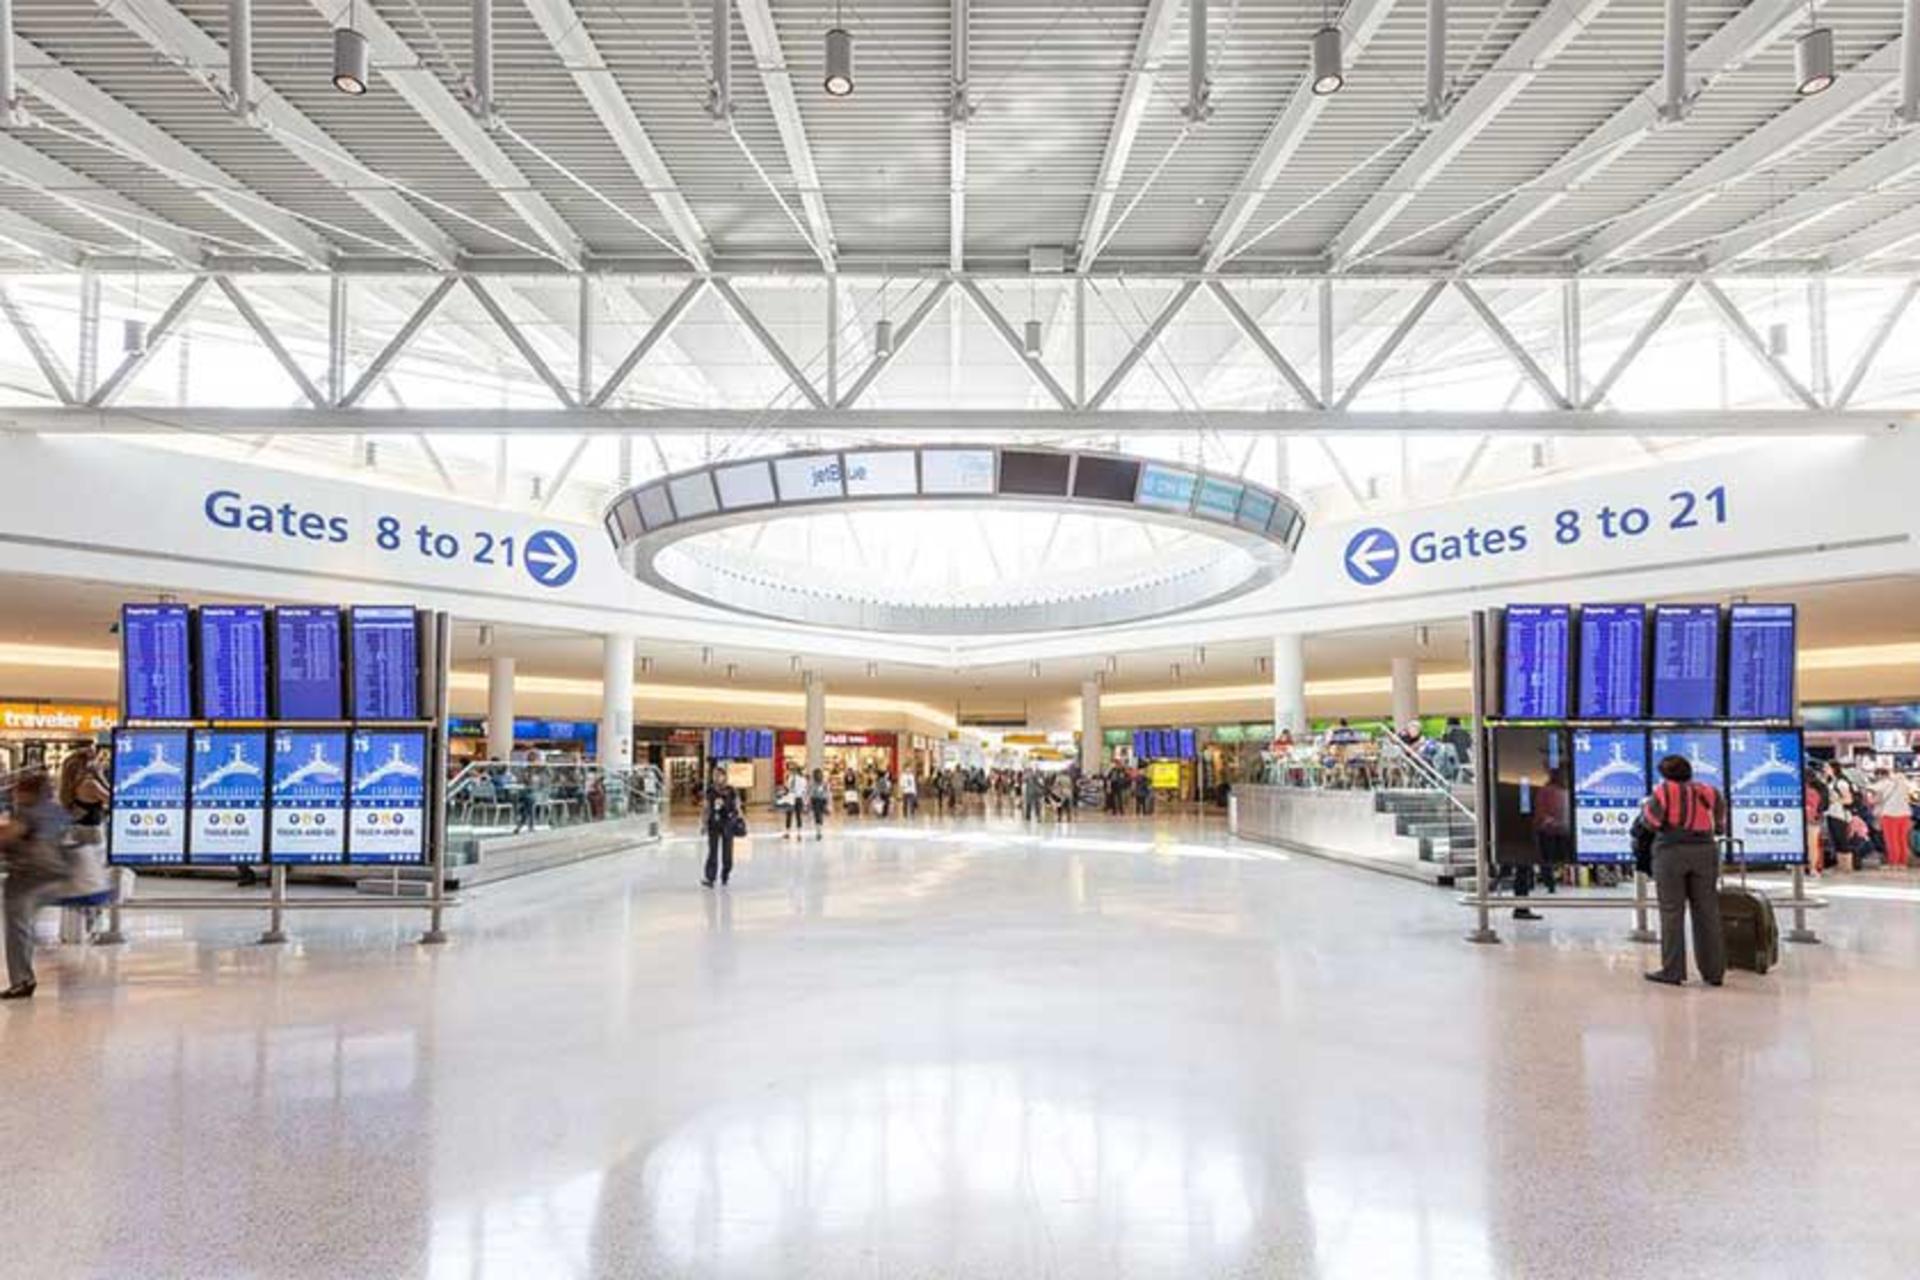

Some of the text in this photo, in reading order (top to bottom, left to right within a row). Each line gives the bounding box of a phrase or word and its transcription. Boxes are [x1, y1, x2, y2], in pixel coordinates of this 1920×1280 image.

[810, 463, 867, 487] jetBue
[204, 490, 514, 567] Gates 8 to 21
[1410, 486, 1726, 564] Gates 8 to 21
